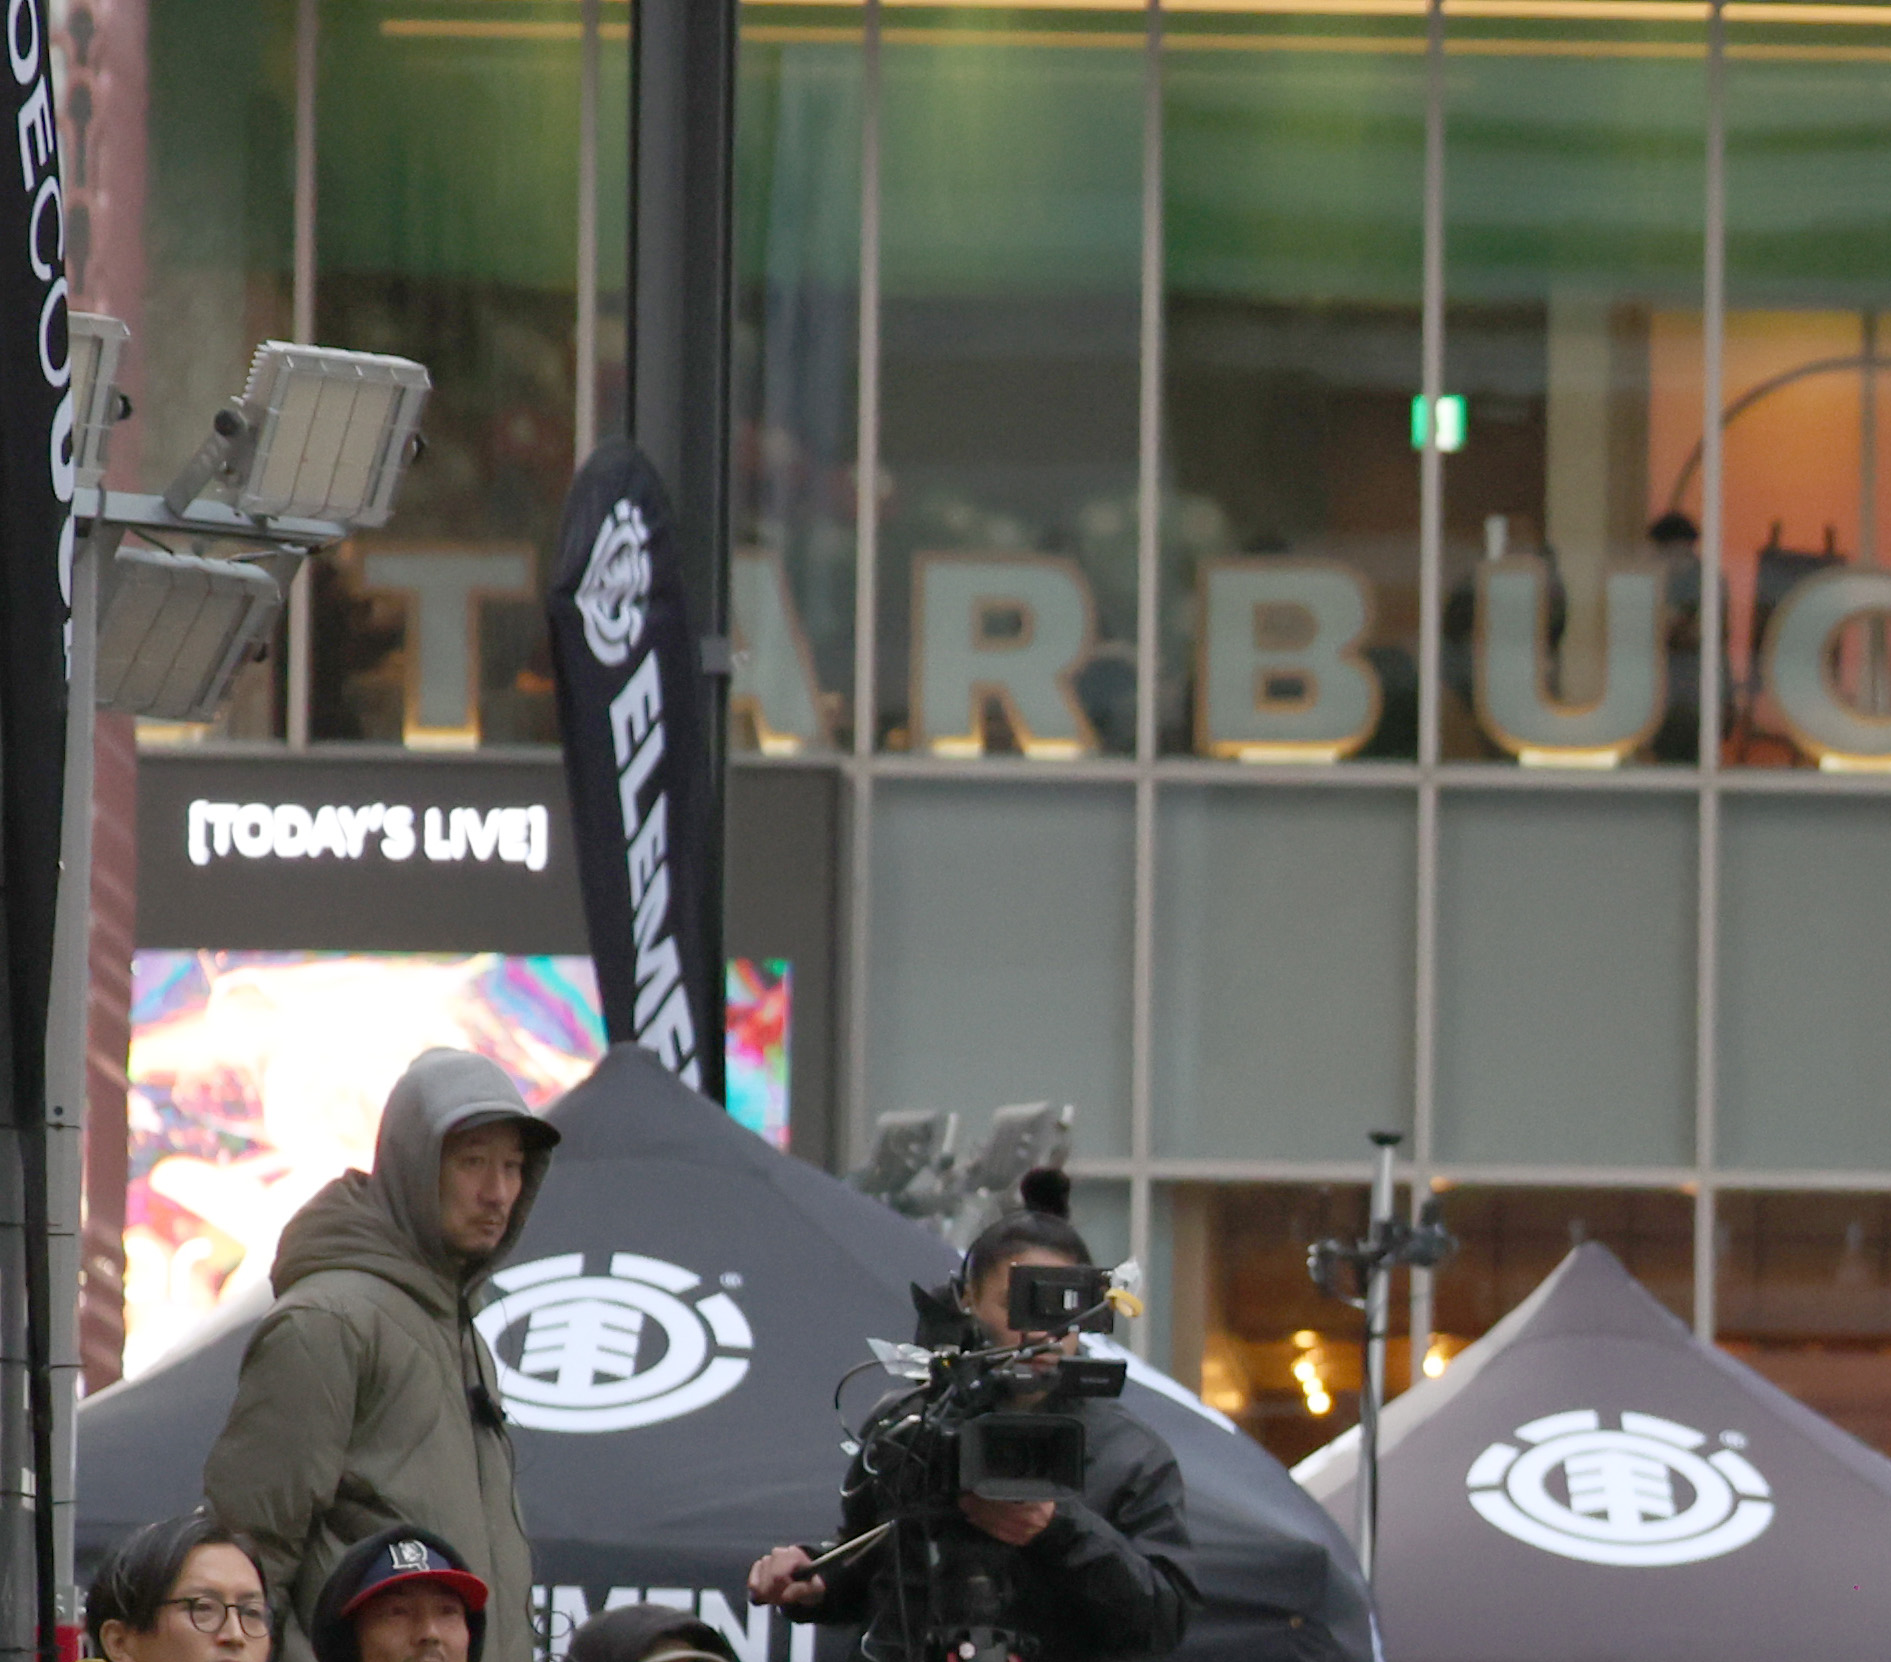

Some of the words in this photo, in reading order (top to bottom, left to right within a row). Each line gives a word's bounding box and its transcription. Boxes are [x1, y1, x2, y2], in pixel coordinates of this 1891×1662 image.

[187, 799, 416, 866] [TODAY'S
[424, 804, 548, 872] LIVE]
[609, 650, 700, 1094] ELEME
